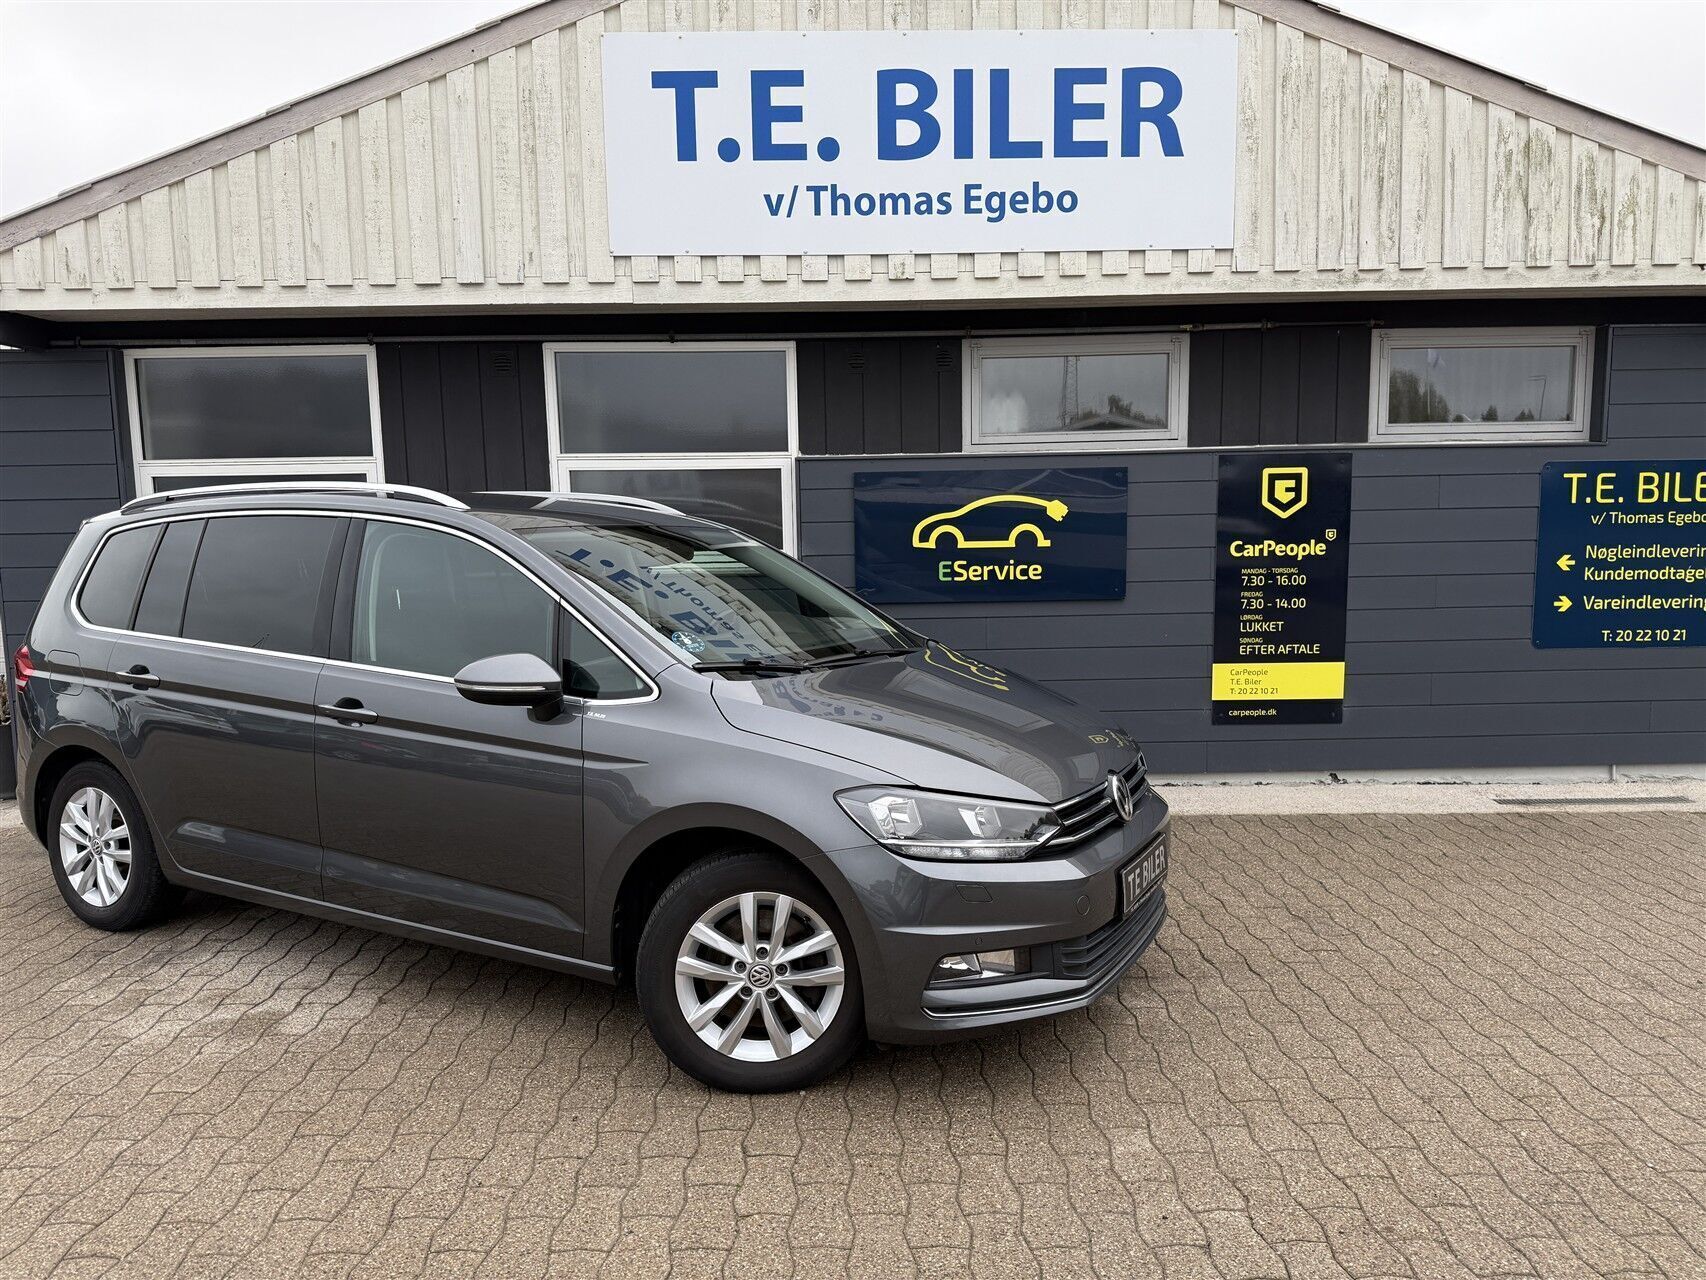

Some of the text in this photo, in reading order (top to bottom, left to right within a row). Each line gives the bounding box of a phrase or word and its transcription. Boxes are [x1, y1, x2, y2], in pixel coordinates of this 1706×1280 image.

[651, 67, 1185, 163] T.E. BILER
[763, 181, 1079, 222] v/ Thomas Egebo
[1563, 472, 1624, 504] T.E.
[1591, 512, 1607, 525] v/
[1609, 511, 1664, 524] Thomas
[1230, 539, 1327, 560] CarPeople
[938, 559, 1042, 582] EService
[1584, 565, 1706, 583] Kundemodtage
[1241, 575, 1265, 586] 7.30
[1276, 575, 1307, 586] 16.00
[1241, 599, 1264, 609] 7.30
[1275, 598, 1306, 609] 14.00
[1583, 594, 1706, 612] Vareindleverin
[1240, 621, 1284, 632] LUKKET
[1602, 629, 1687, 642] T: 20 22 10 21
[1239, 644, 1320, 655] EFTER AFTALE
[1228, 709, 1277, 717] carpeople.dk
[1128, 867, 1141, 902] TE
[1142, 845, 1166, 889] BILER
